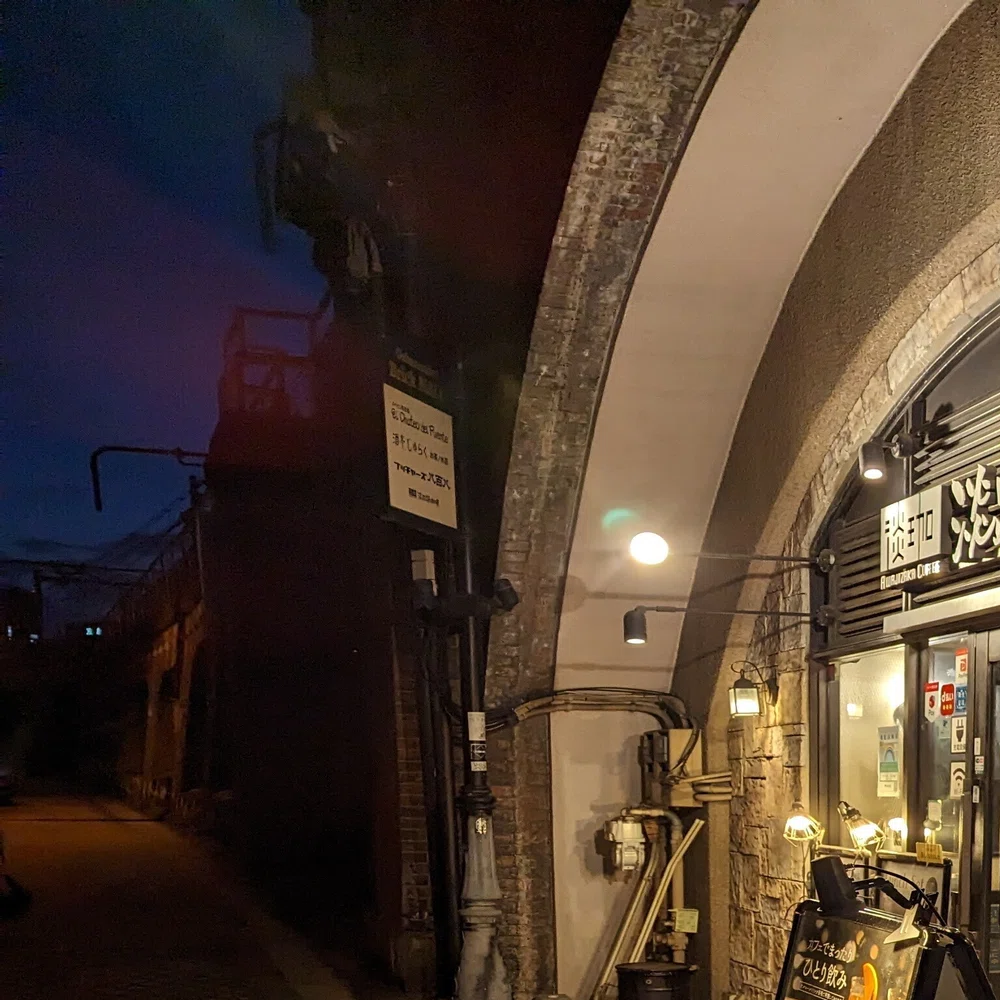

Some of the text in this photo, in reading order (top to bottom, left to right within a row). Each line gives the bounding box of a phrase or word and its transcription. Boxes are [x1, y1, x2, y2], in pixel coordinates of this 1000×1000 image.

[808, 940, 852, 963] カフェでまったり
[803, 959, 847, 990] ひとり飲み
